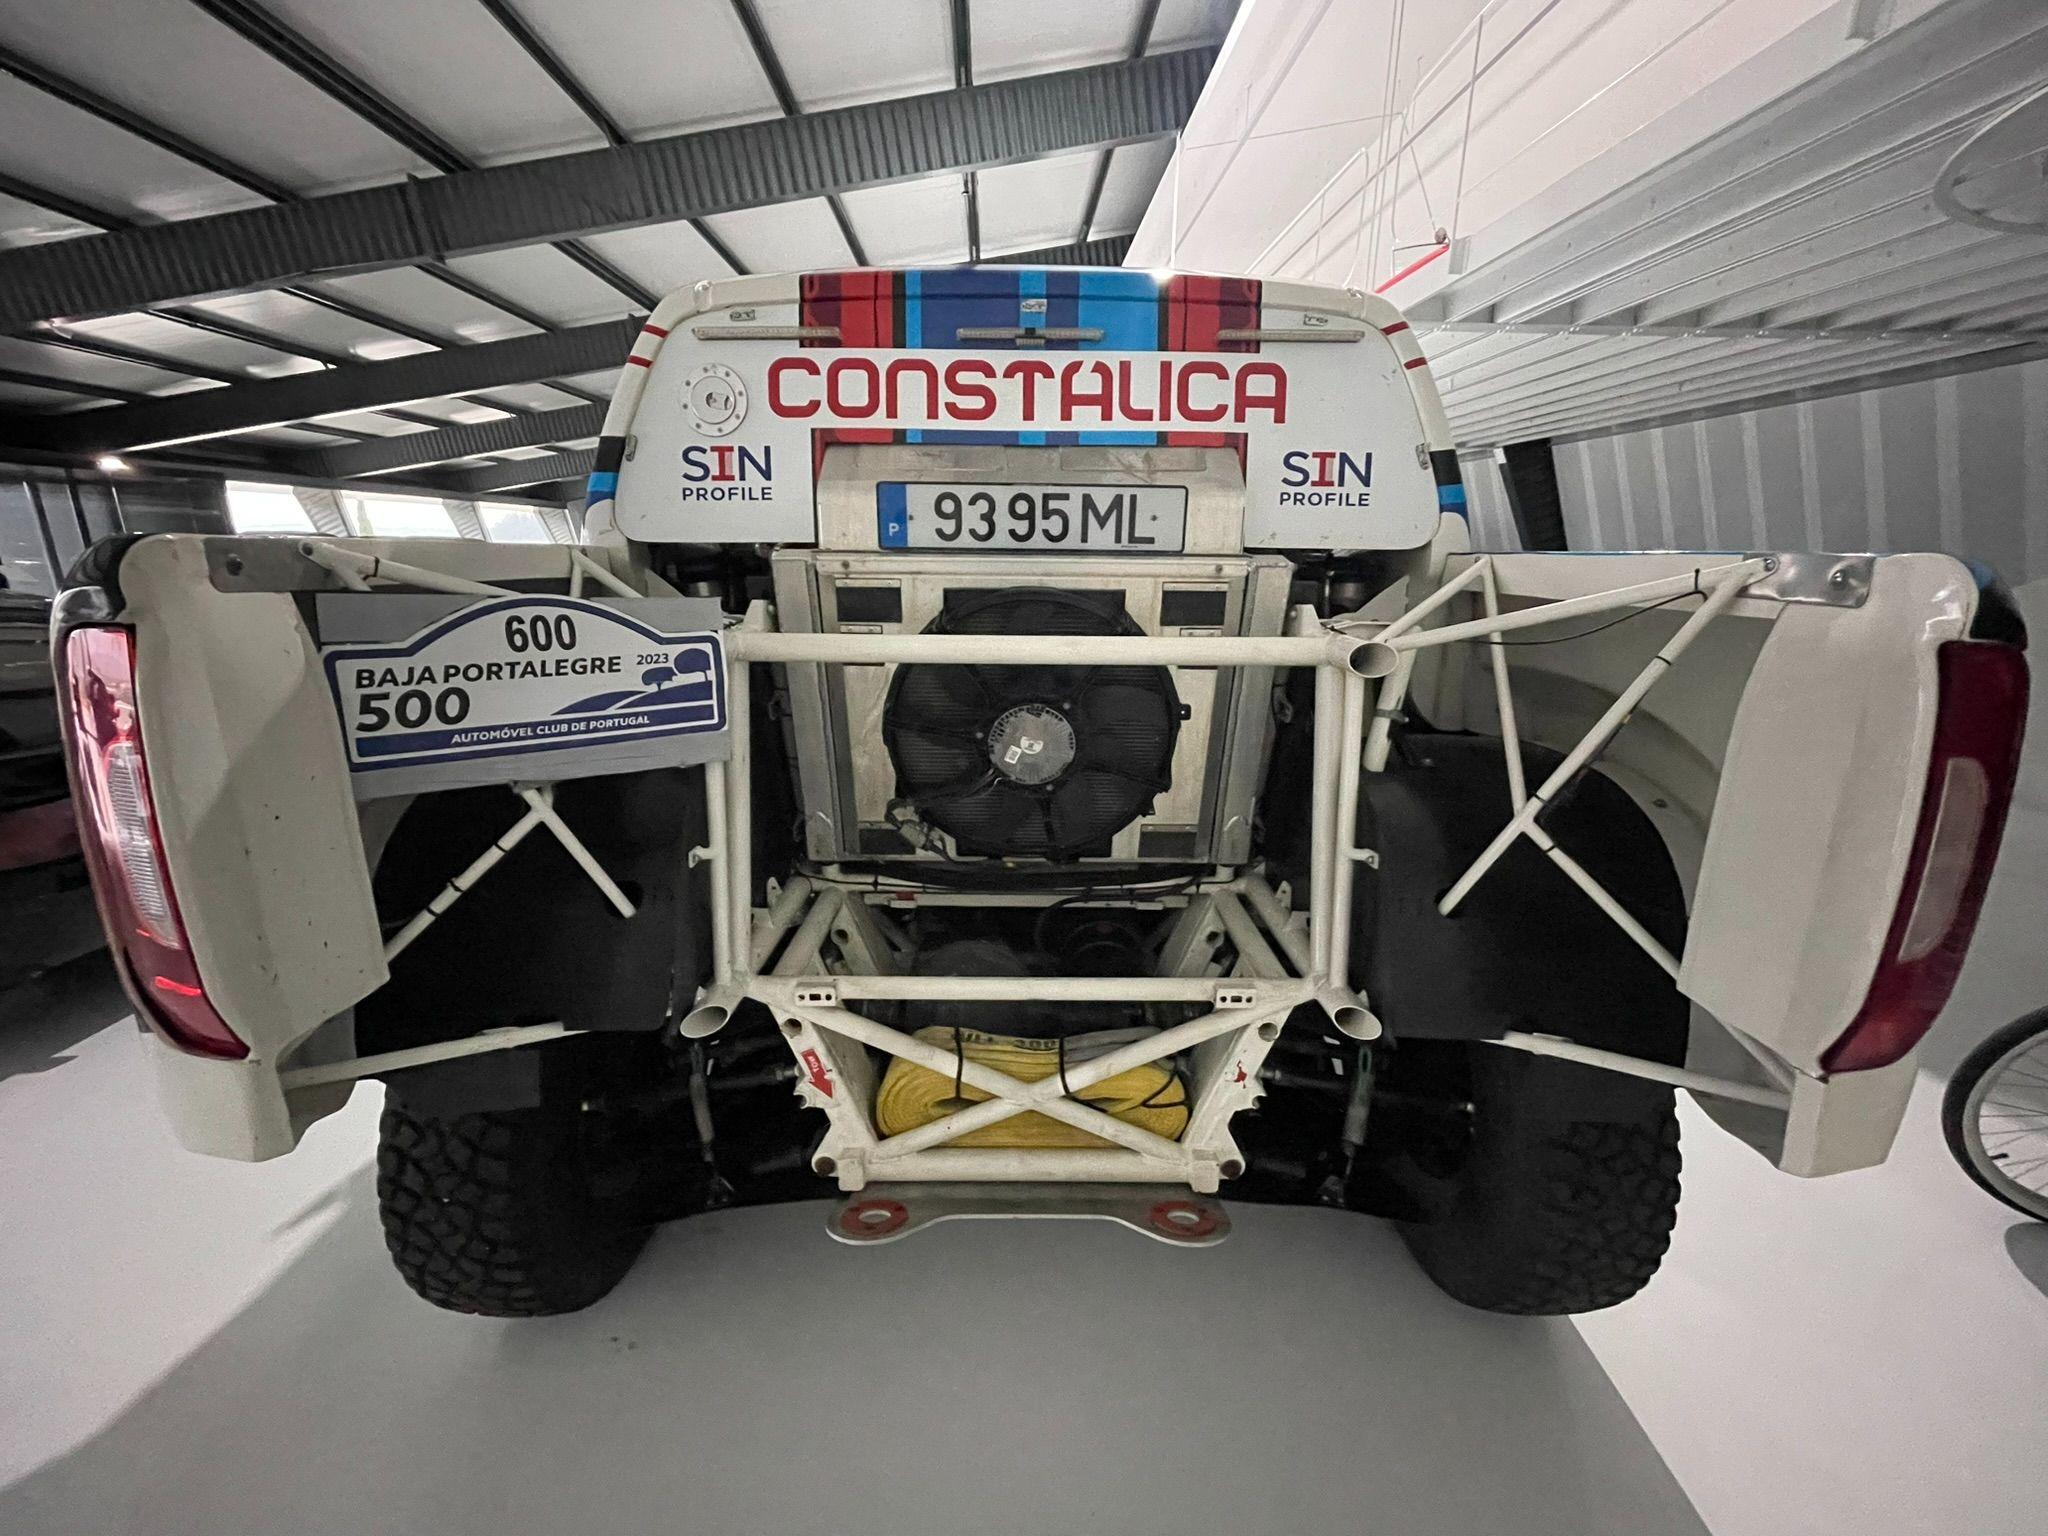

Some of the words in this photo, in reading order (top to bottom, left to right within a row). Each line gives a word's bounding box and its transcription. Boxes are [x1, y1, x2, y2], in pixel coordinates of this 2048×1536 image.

[681, 445, 772, 482] SIN
[1281, 450, 1372, 488] SIN
[682, 486, 773, 501] PROFILE
[1279, 491, 1371, 507] PROFILE
[888, 522, 900, 537] P
[504, 613, 577, 653] 600
[355, 665, 437, 689] BAJA
[443, 655, 622, 684] PORTALEGRE
[636, 653, 669, 666] 2023
[355, 686, 470, 733] 500
[451, 726, 534, 744] AUTOMÓVEL
[536, 723, 568, 735] CLUB
[571, 721, 587, 731] DE
[589, 715, 651, 730] PORTUGAL
